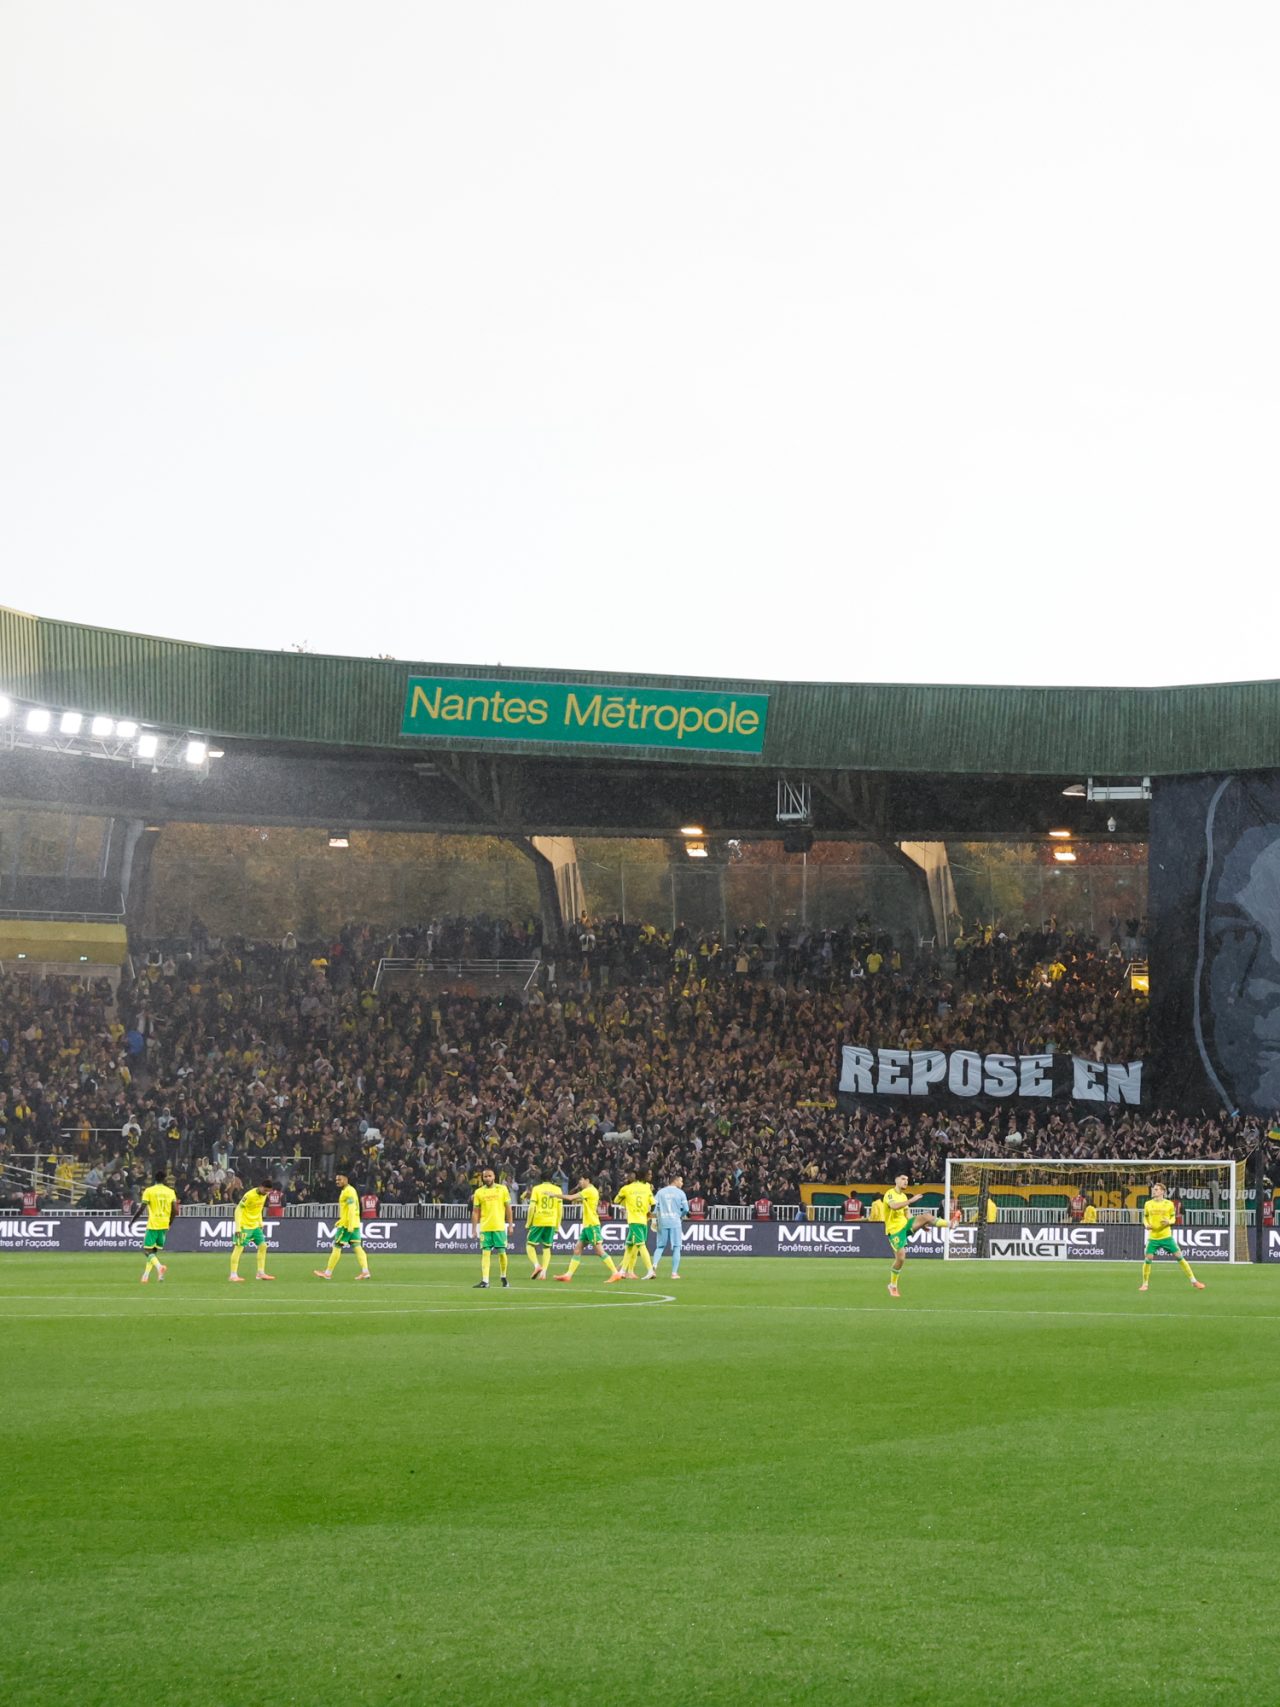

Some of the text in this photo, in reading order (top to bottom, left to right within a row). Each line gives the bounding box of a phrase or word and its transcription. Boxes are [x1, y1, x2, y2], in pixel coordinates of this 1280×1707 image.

[410, 686, 548, 724] Nantes
[839, 1045, 1143, 1105] REPOSE EN
[1179, 1187, 1210, 1199] POUR
[541, 1196, 554, 1209] 80
[636, 1196, 643, 1209] 6
[85, 1221, 148, 1237] MILLE
[317, 1222, 398, 1239] MLET
[778, 1225, 860, 1242] MILLET
[84, 1239, 117, 1247] Fenêtres
[1021, 1228, 1104, 1245] MILLET
[1145, 1229, 1228, 1246] ILLET
[25, 1239, 60, 1248] Façades
[362, 1241, 397, 1250] Façades
[435, 1241, 468, 1249] Fenêtres
[680, 1243, 705, 1251] nêtres
[717, 1243, 752, 1253] Façades
[778, 1243, 860, 1253] Fenêtres et Façades
[992, 1243, 1065, 1256] MILLET
[1067, 1247, 1104, 1256] Façades
[1192, 1248, 1229, 1258] Façades
